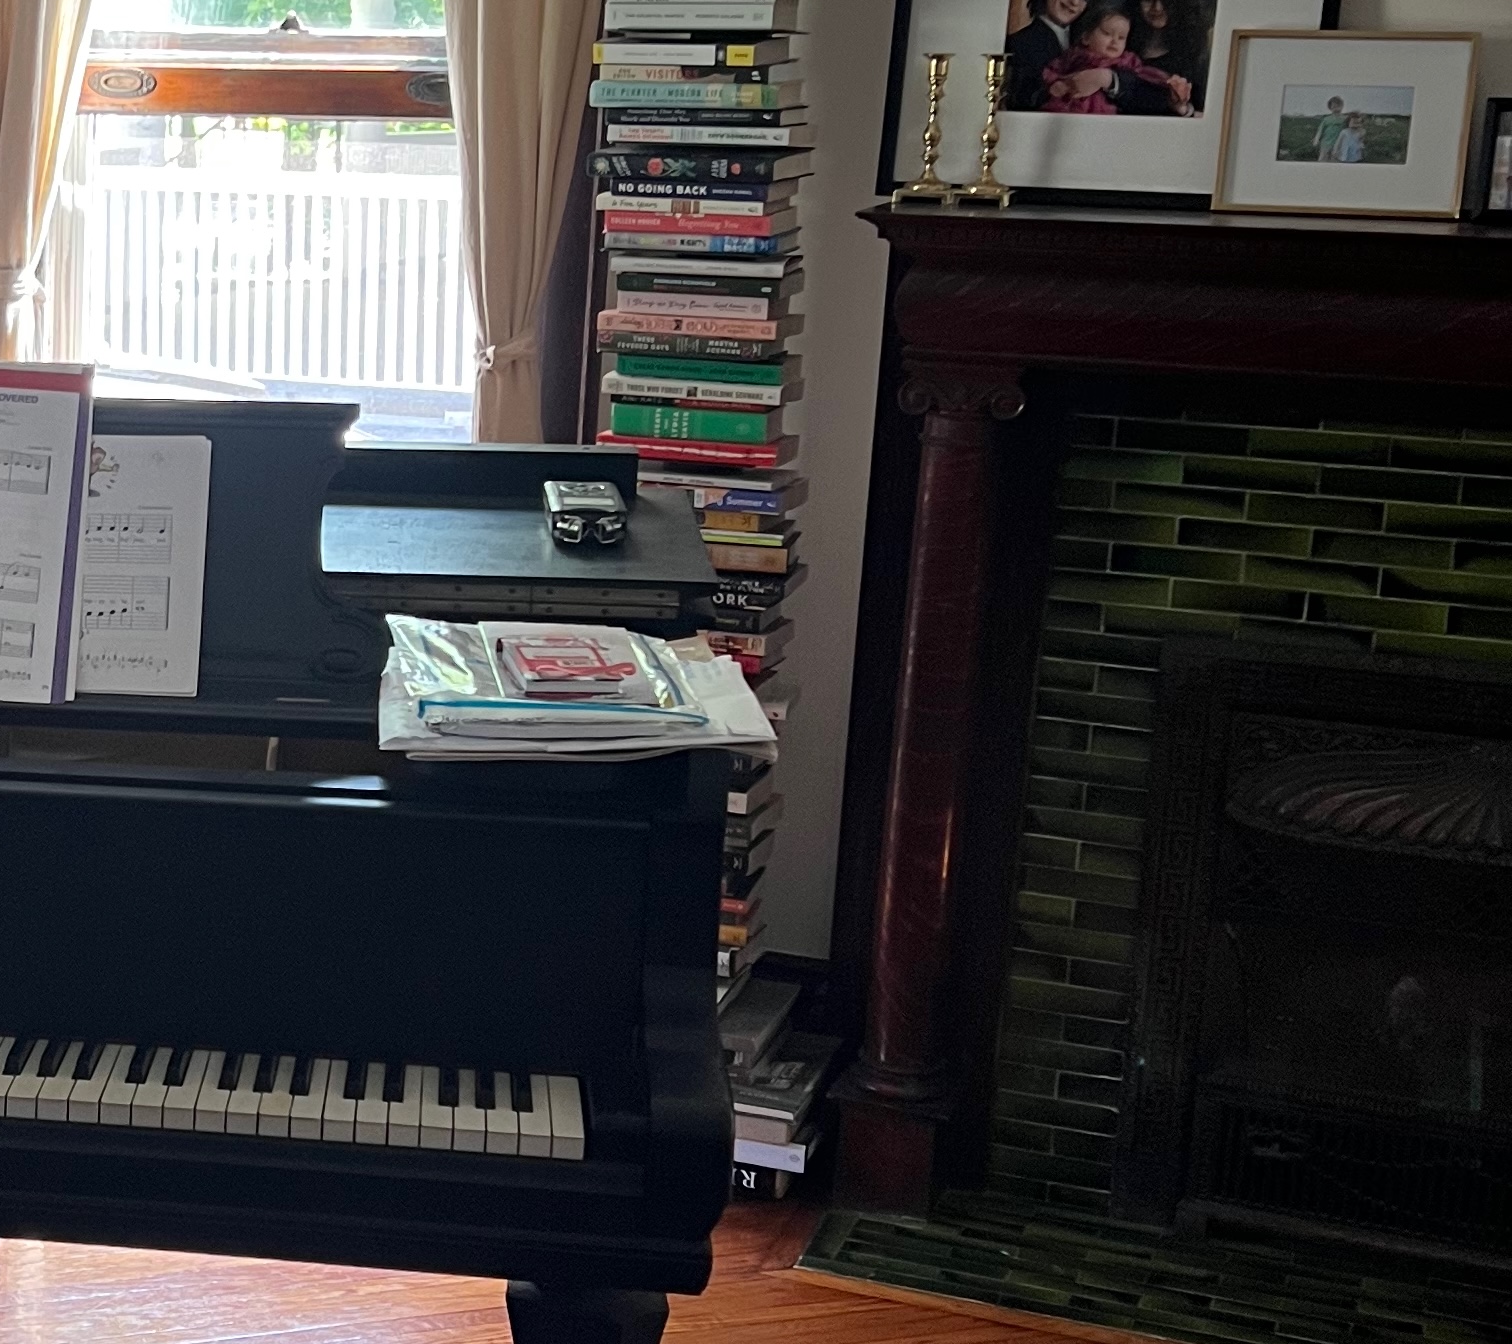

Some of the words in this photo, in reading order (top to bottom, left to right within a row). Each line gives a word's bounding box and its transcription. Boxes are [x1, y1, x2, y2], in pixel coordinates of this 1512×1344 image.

[601, 87, 616, 97] THE
[620, 87, 658, 97] PLANTER
[667, 88, 701, 98] MODERN
[705, 88, 724, 98] LIFE
[617, 182, 635, 193] NO
[636, 183, 673, 195] GOING
[675, 184, 708, 196] BACK
[609, 216, 636, 225] COLLEEN
[637, 217, 662, 226] HOOVER
[723, 219, 740, 230] You
[632, 335, 656, 344] THESE
[707, 339, 739, 348] MARTHA
[616, 342, 650, 351] FEVERED
[650, 343, 670, 352] DAYS
[627, 383, 646, 392] THOSE
[646, 384, 660, 393] WHO
[661, 385, 684, 395] FORGET
[735, 390, 764, 401] SCHWARZ
[670, 410, 680, 439] LYDIA
[680, 411, 690, 440] DAVIS
[726, 495, 764, 507] Summer
